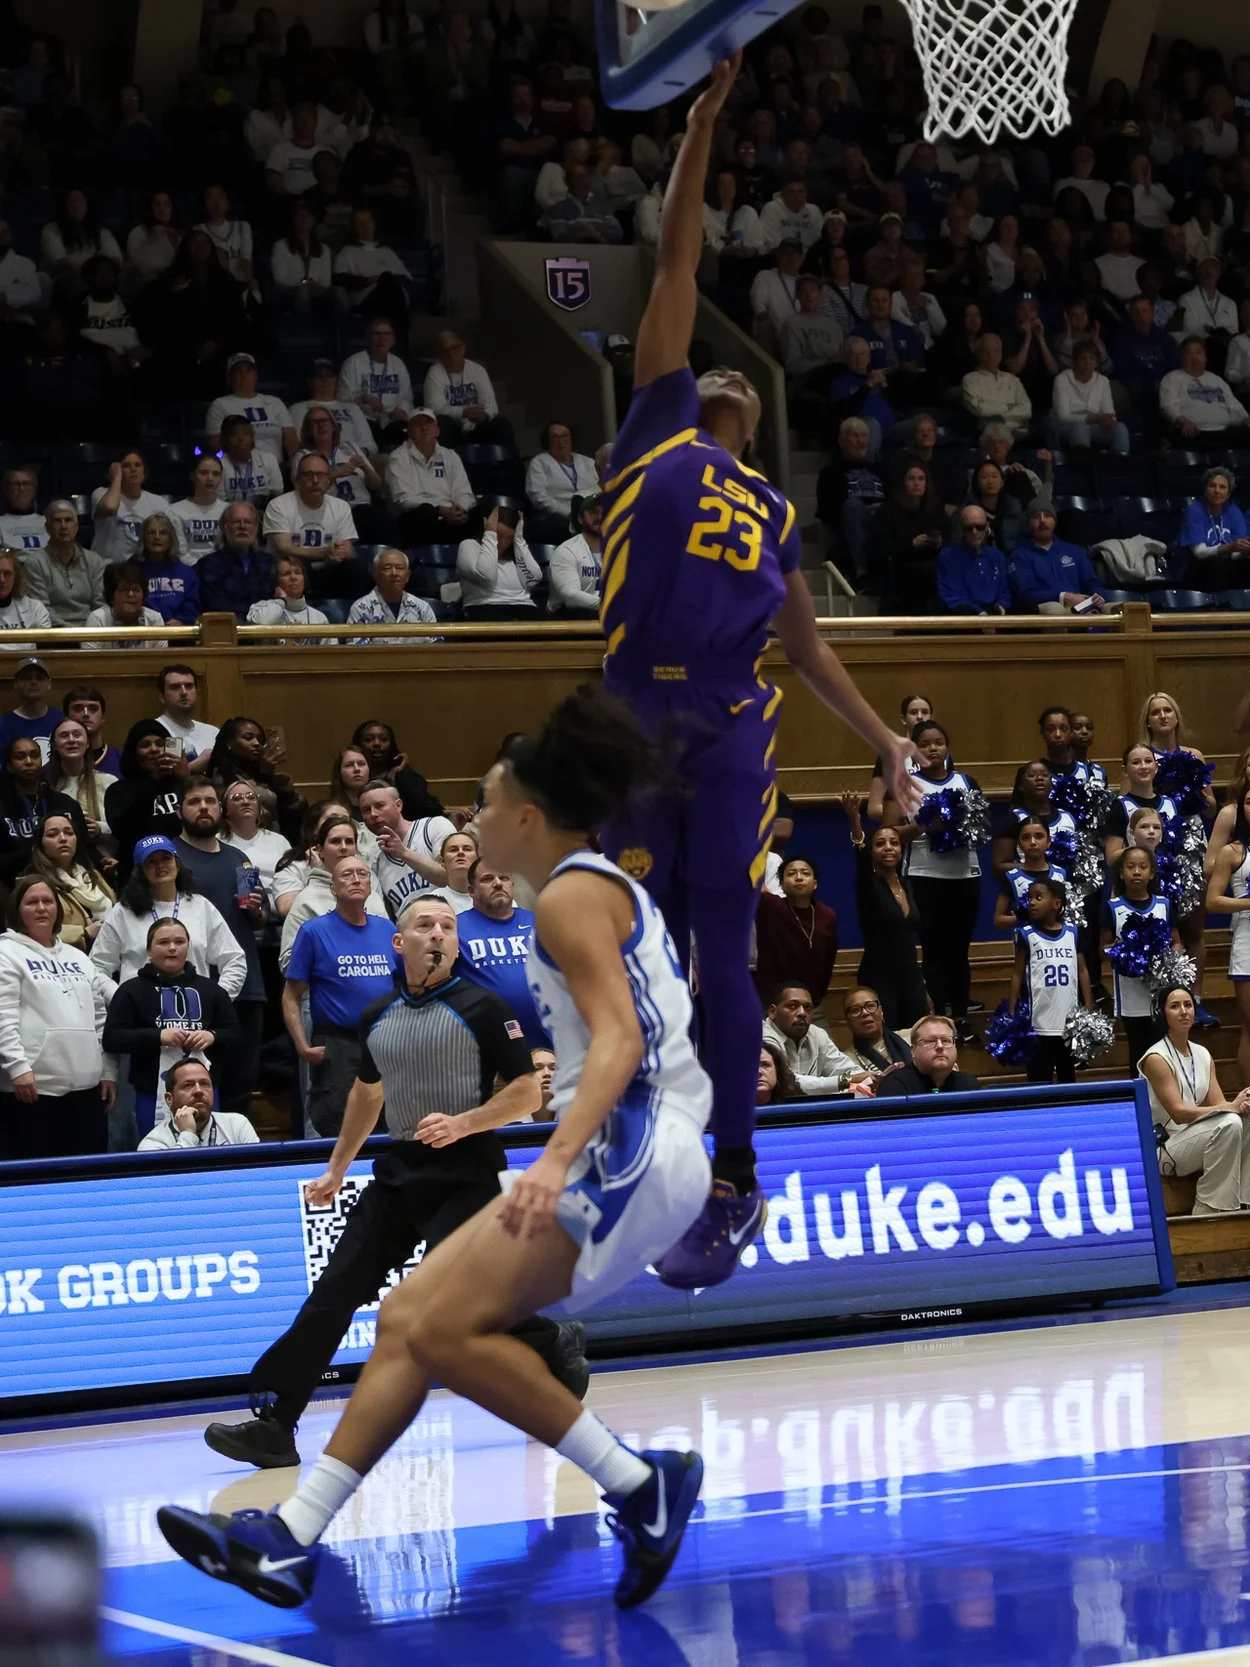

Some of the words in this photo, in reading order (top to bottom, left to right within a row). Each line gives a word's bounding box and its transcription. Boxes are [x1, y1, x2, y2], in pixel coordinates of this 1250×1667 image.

[554, 271, 585, 299] 15
[229, 475, 266, 490] DUKE
[701, 463, 769, 520] LSU
[305, 529, 322, 547] D
[685, 496, 763, 571] 23
[142, 836, 164, 847] DUKE
[388, 871, 430, 908] DUKE
[468, 935, 532, 960] DUK
[1036, 948, 1073, 960] DUKE
[26, 959, 85, 976] DUKE
[337, 955, 353, 965] GO
[354, 955, 367, 964] TO
[368, 954, 388, 964] HELL
[475, 958, 527, 969] BASKETB
[338, 965, 391, 977] CAROLINA
[1044, 964, 1069, 987] 26
[155, 985, 202, 1021] D
[739, 1147, 1135, 1268] .duke.edu
[0, 1268, 45, 1316] K
[58, 1250, 260, 1310] GROUPS
[901, 1308, 962, 1321] DAKTRONICS
